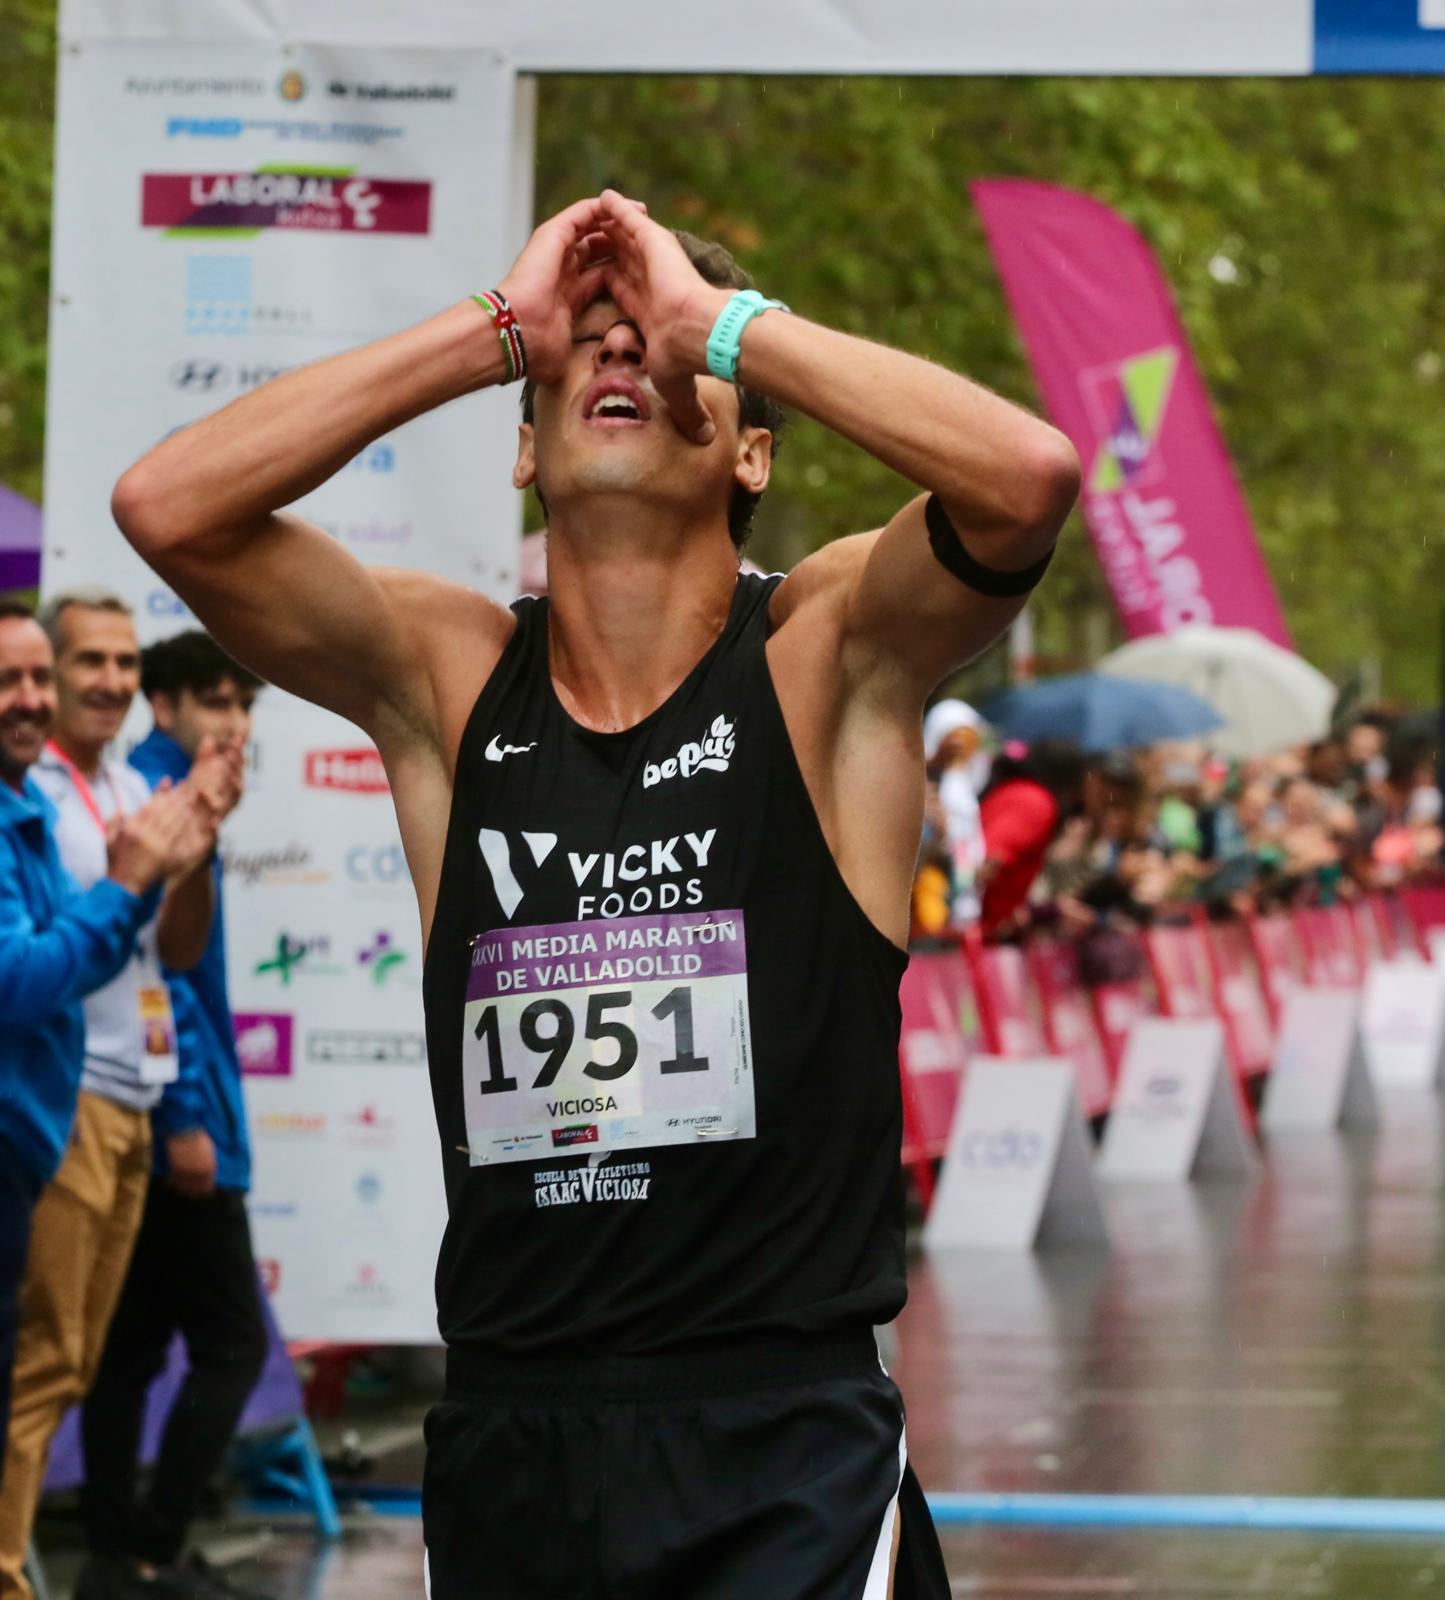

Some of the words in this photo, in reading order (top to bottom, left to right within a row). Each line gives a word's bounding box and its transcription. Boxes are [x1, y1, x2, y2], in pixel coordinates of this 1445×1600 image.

[190, 174, 340, 208] LABORAL
[567, 828, 717, 888] VICKY
[577, 878, 703, 921] FOODS
[511, 932, 598, 961] MEDIA
[605, 916, 737, 952] MARATÓN
[496, 967, 528, 992] DE
[534, 953, 702, 987] VALLADOLID
[474, 986, 709, 1096] 1951
[546, 1095, 618, 1118] VICIOSA
[534, 1170, 566, 1184] ESCUELA
[568, 1169, 580, 1182] DE
[598, 1162, 651, 1180] ATLETISMO
[535, 1181, 580, 1208] ISAAC
[577, 1167, 652, 1203] VICIOSA
